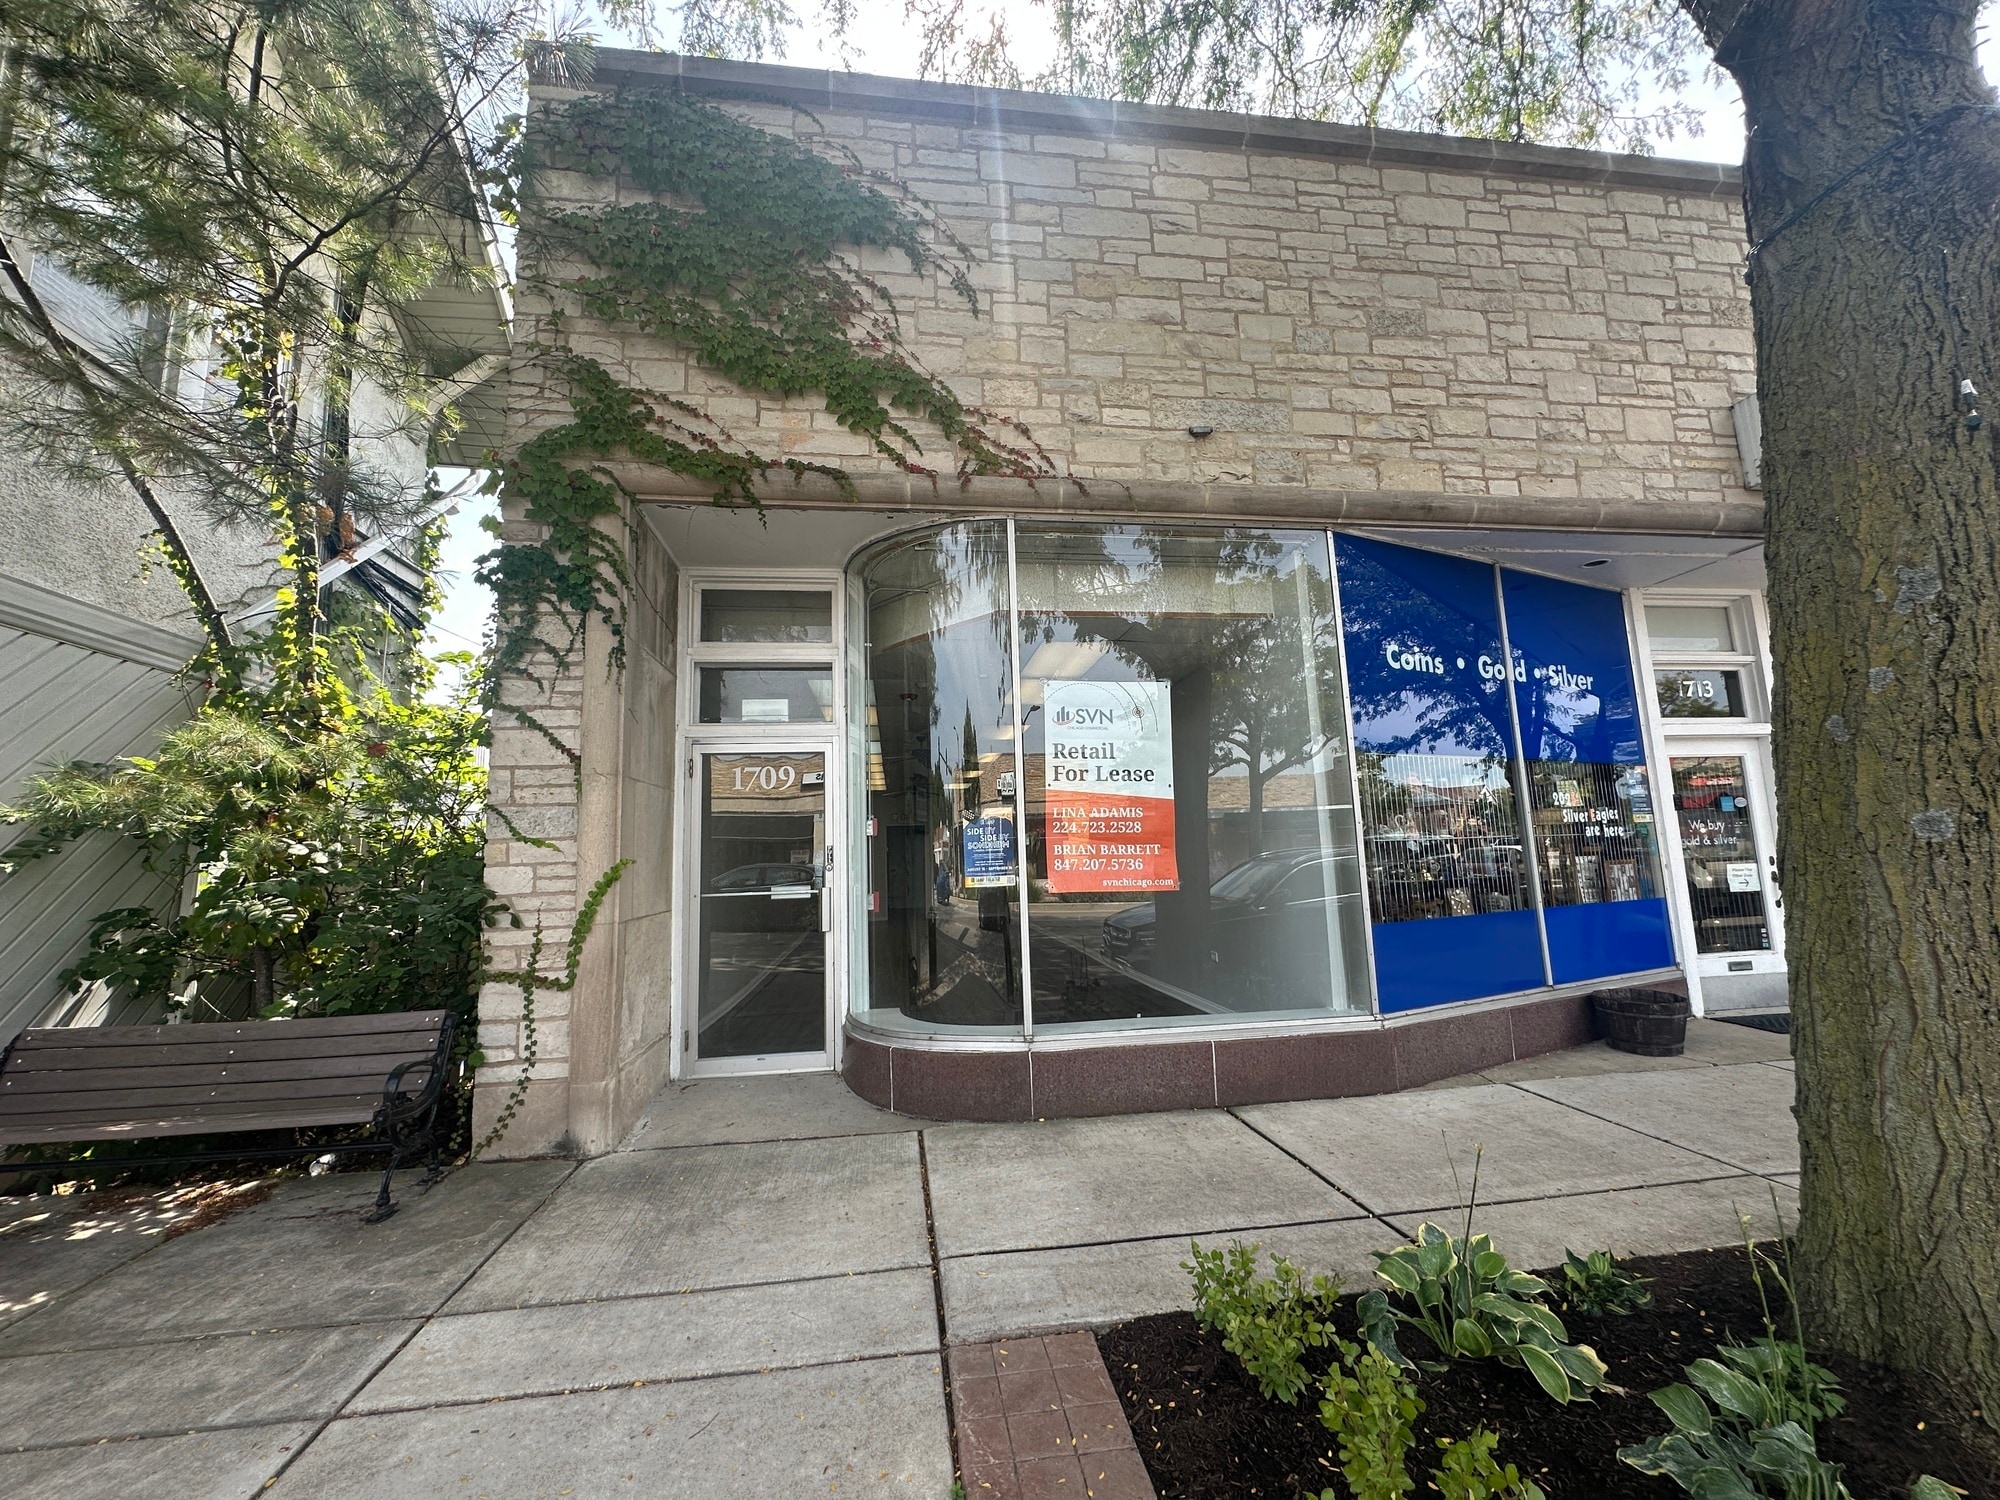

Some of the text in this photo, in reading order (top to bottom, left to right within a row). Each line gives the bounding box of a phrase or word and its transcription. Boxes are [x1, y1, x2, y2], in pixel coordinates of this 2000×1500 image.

[1386, 644, 1593, 690] Coins God Silver
[1678, 680, 1714, 698] 1713
[1075, 708, 1114, 725] SVN
[1052, 742, 1116, 760] Retail
[732, 765, 796, 792] 1709
[1052, 765, 1155, 782] For Lease
[1052, 807, 1144, 818] LINA ADAMIS
[1562, 807, 1619, 824] Silver Eagles
[1052, 821, 1142, 834] 224.723.2528
[1585, 824, 1625, 838] are here
[1688, 819, 1726, 834] We buy
[1053, 844, 1161, 855] BRIAN BARRETT
[1681, 835, 1701, 849] gold
[1703, 835, 1712, 846] &
[1054, 858, 1144, 871] 847.207.5736
[1102, 877, 1174, 888] svnchicago.com
